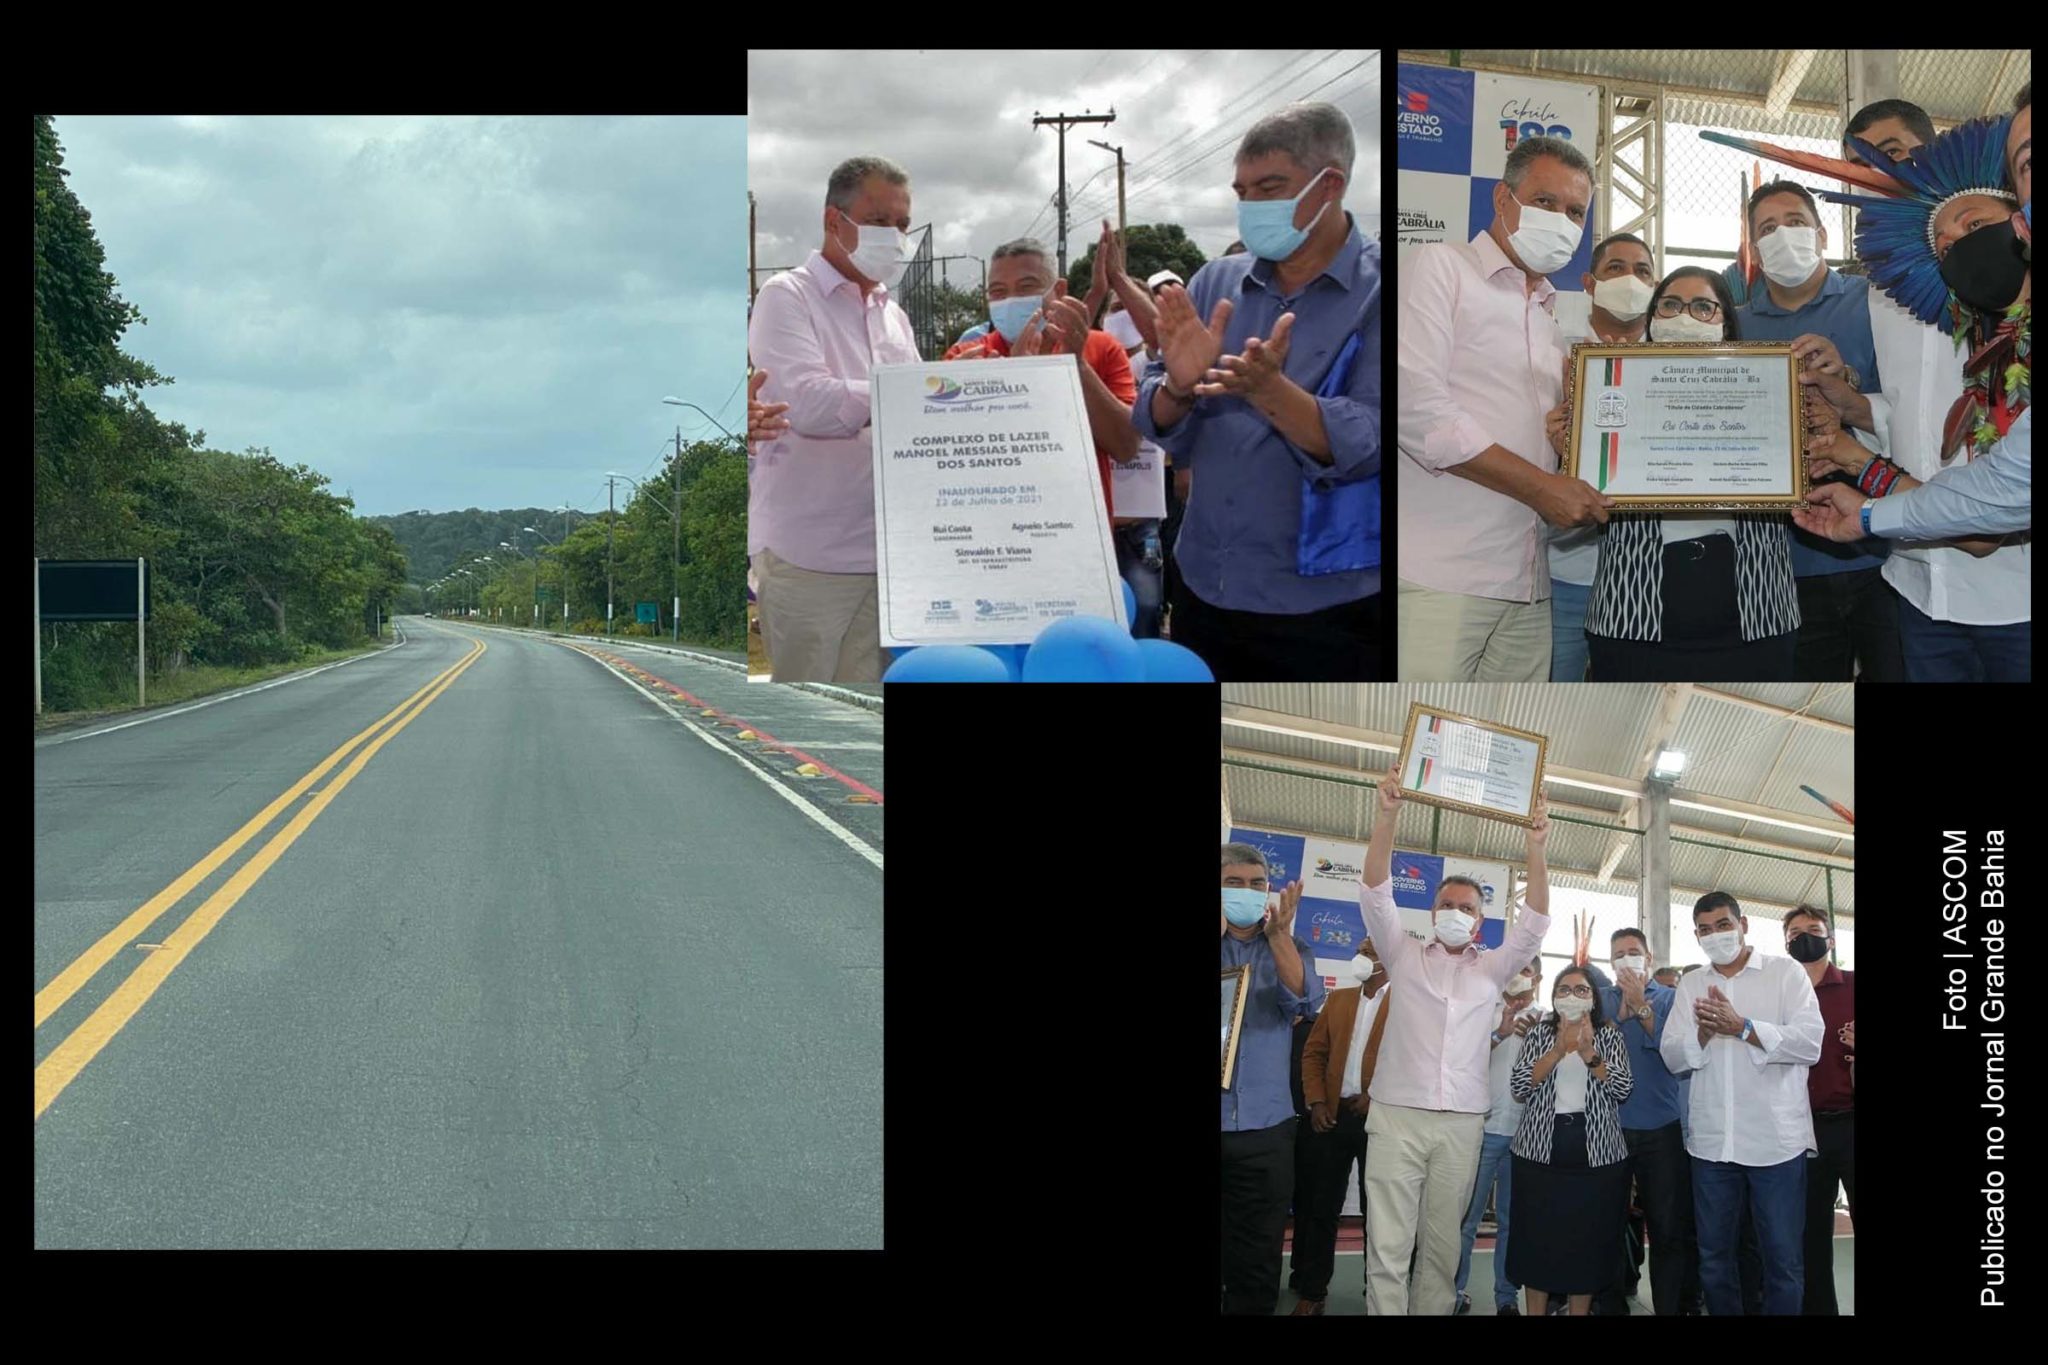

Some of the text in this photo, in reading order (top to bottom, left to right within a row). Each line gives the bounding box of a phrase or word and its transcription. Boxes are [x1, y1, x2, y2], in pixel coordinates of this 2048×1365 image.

[1398, 112, 1440, 125] VERNO
[1662, 366, 1750, 374] Câmara Municipal de
[1651, 375, 1677, 383] Santa
[912, 431, 1050, 446] COMPLEXO DE LAZER
[893, 443, 1064, 459] MANOEL MESSIAS BATISTA
[937, 457, 1022, 469] DOS SANTOS
[938, 485, 1036, 497] INAUGURADO EM
[952, 497, 965, 506] de
[968, 496, 998, 505] Julho
[1000, 495, 1014, 504] de
[933, 525, 972, 533] Rui Costa
[1005, 546, 1032, 555] Viana
